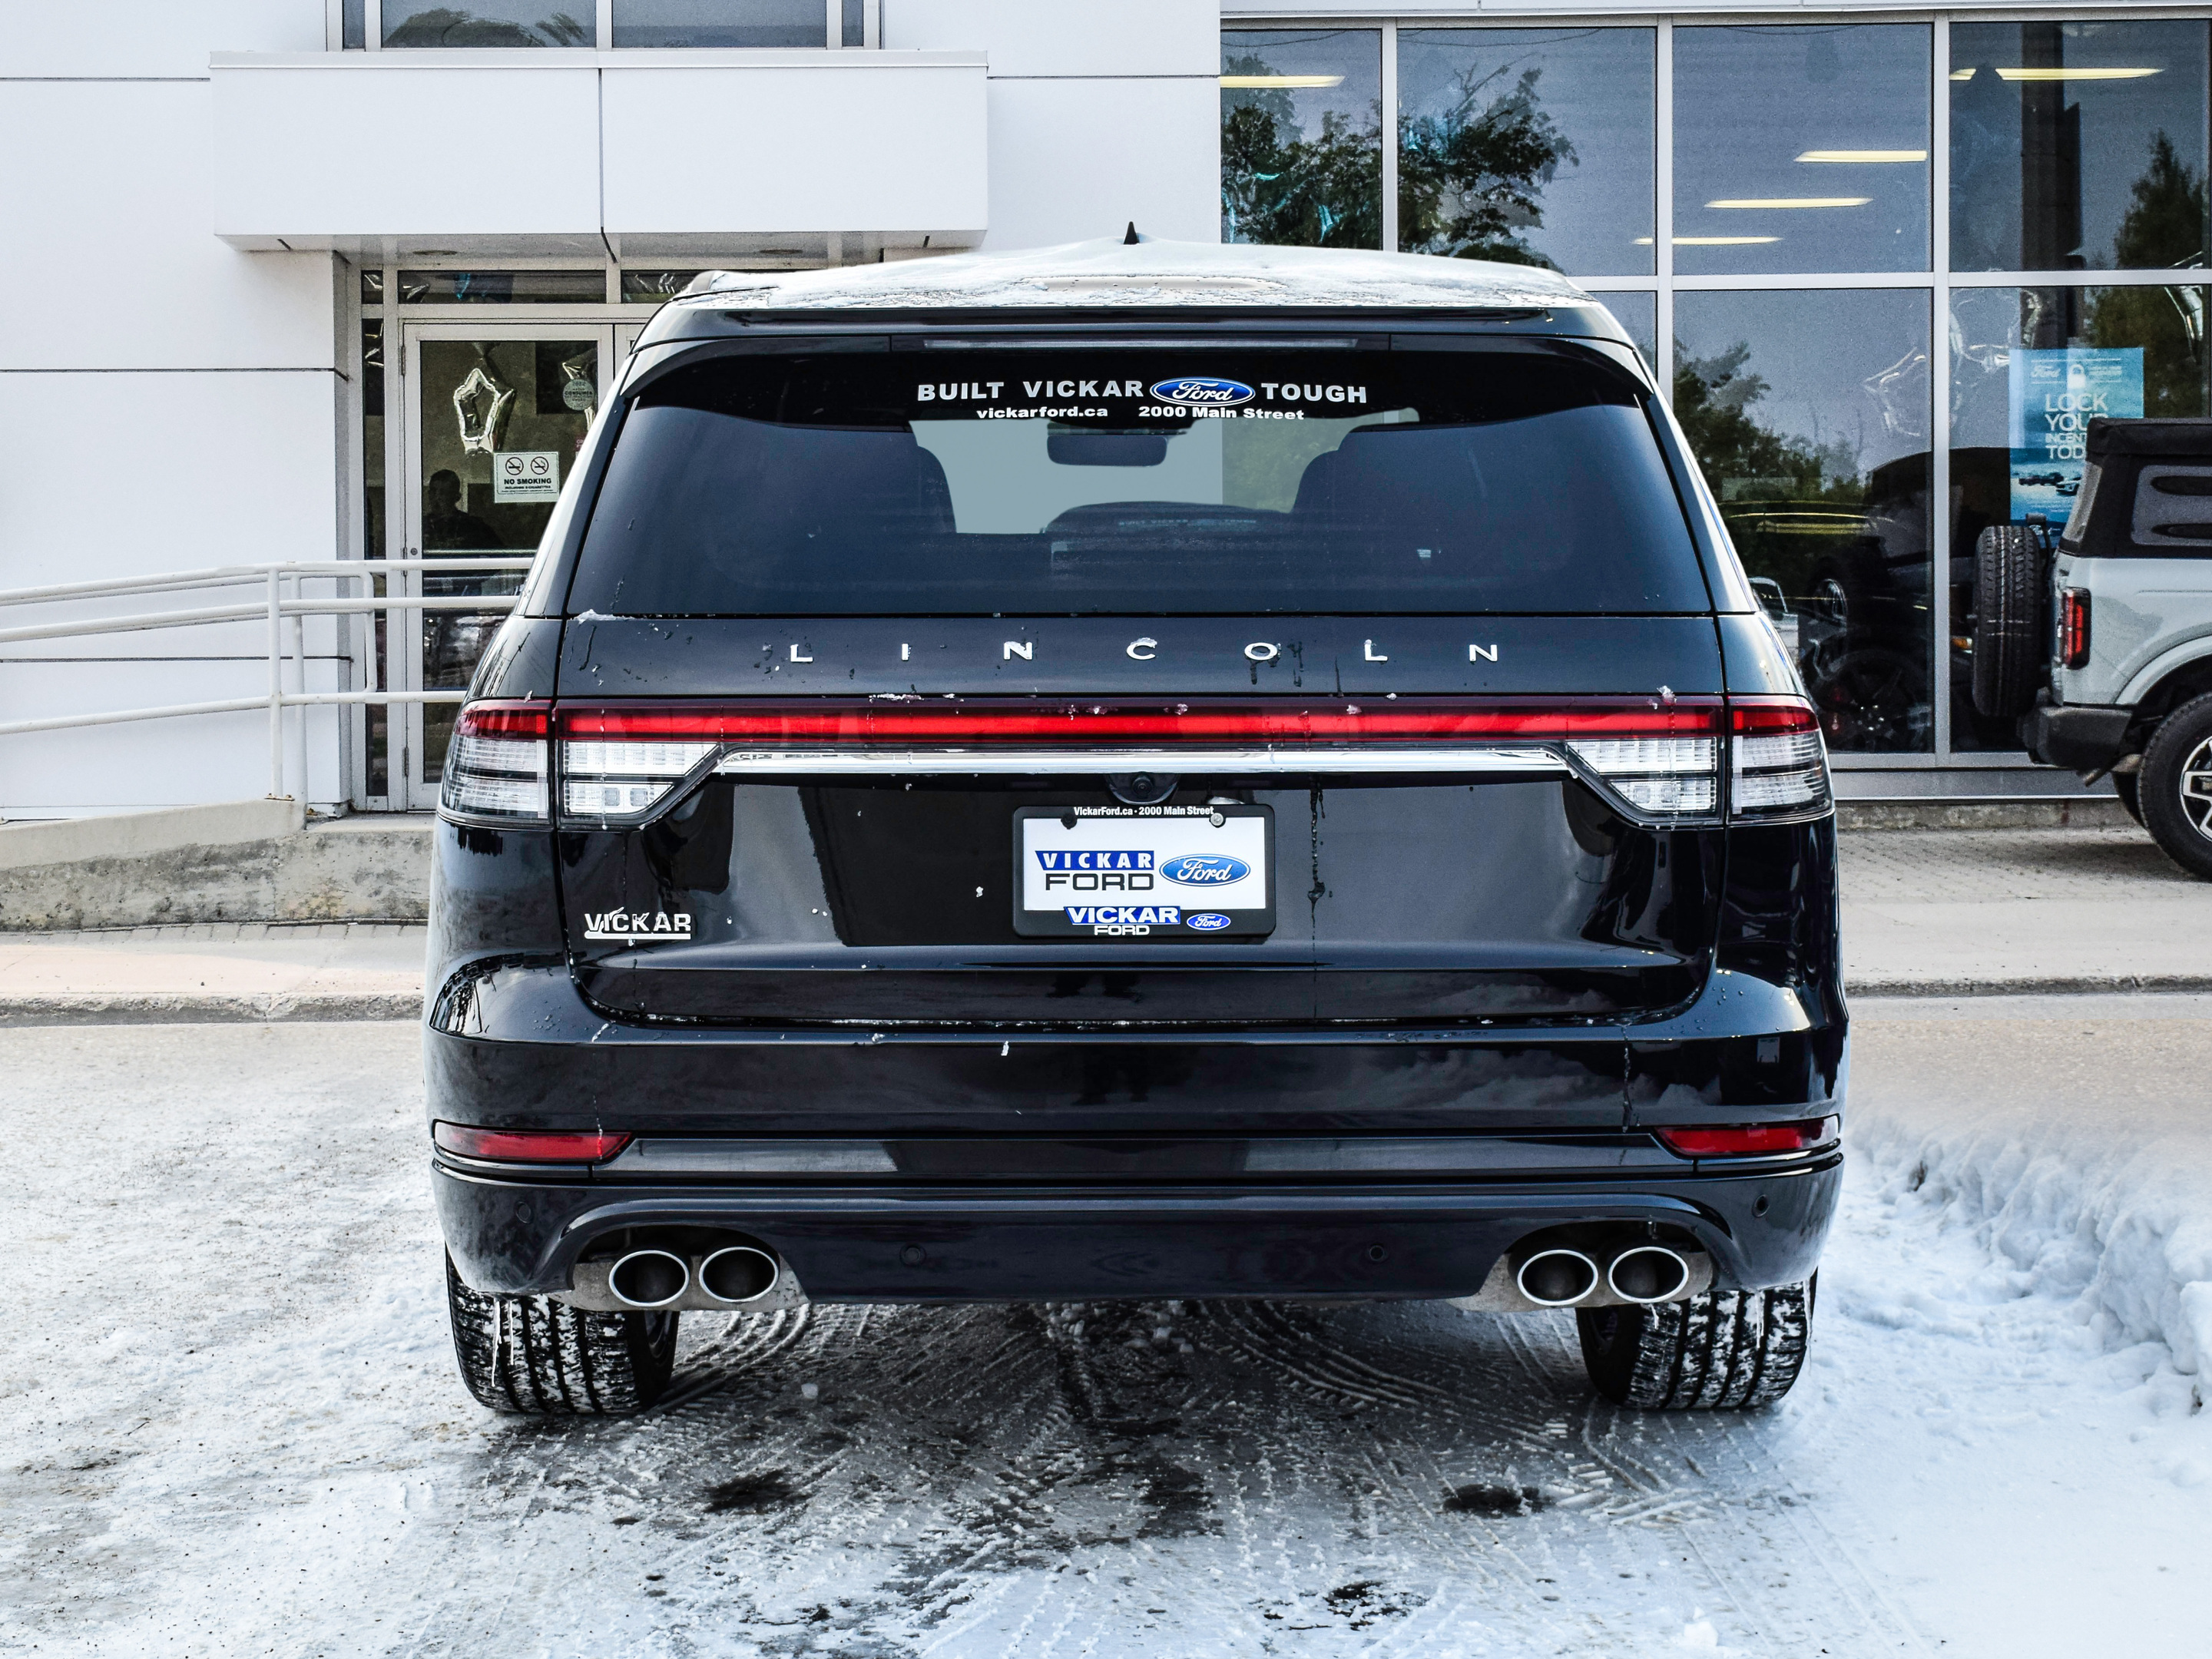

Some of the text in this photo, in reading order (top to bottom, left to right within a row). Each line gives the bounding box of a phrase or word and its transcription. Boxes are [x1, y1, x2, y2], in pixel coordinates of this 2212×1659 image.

[918, 381, 1367, 403] BUILT VICKAR Ford TOUGH
[2045, 393, 2108, 412] LOCK
[977, 406, 1304, 420] vickarford.ca 2000 Main Street
[2045, 413, 2108, 431] YOU
[2045, 432, 2088, 443] INCENT
[2045, 445, 2087, 459] TOD
[790, 641, 1498, 661] LINCOLN
[1138, 806, 1162, 815] 2000
[1164, 806, 1186, 815] Main
[1187, 806, 1214, 815] Street
[1043, 853, 1152, 868] VICKAR
[1177, 859, 1232, 882] Ford
[1045, 873, 1154, 890] FORD
[584, 913, 691, 931] VICKAR
[1067, 907, 1178, 923] VICKAR
[1194, 914, 1222, 927] Ford
[1094, 925, 1150, 935] FORD
